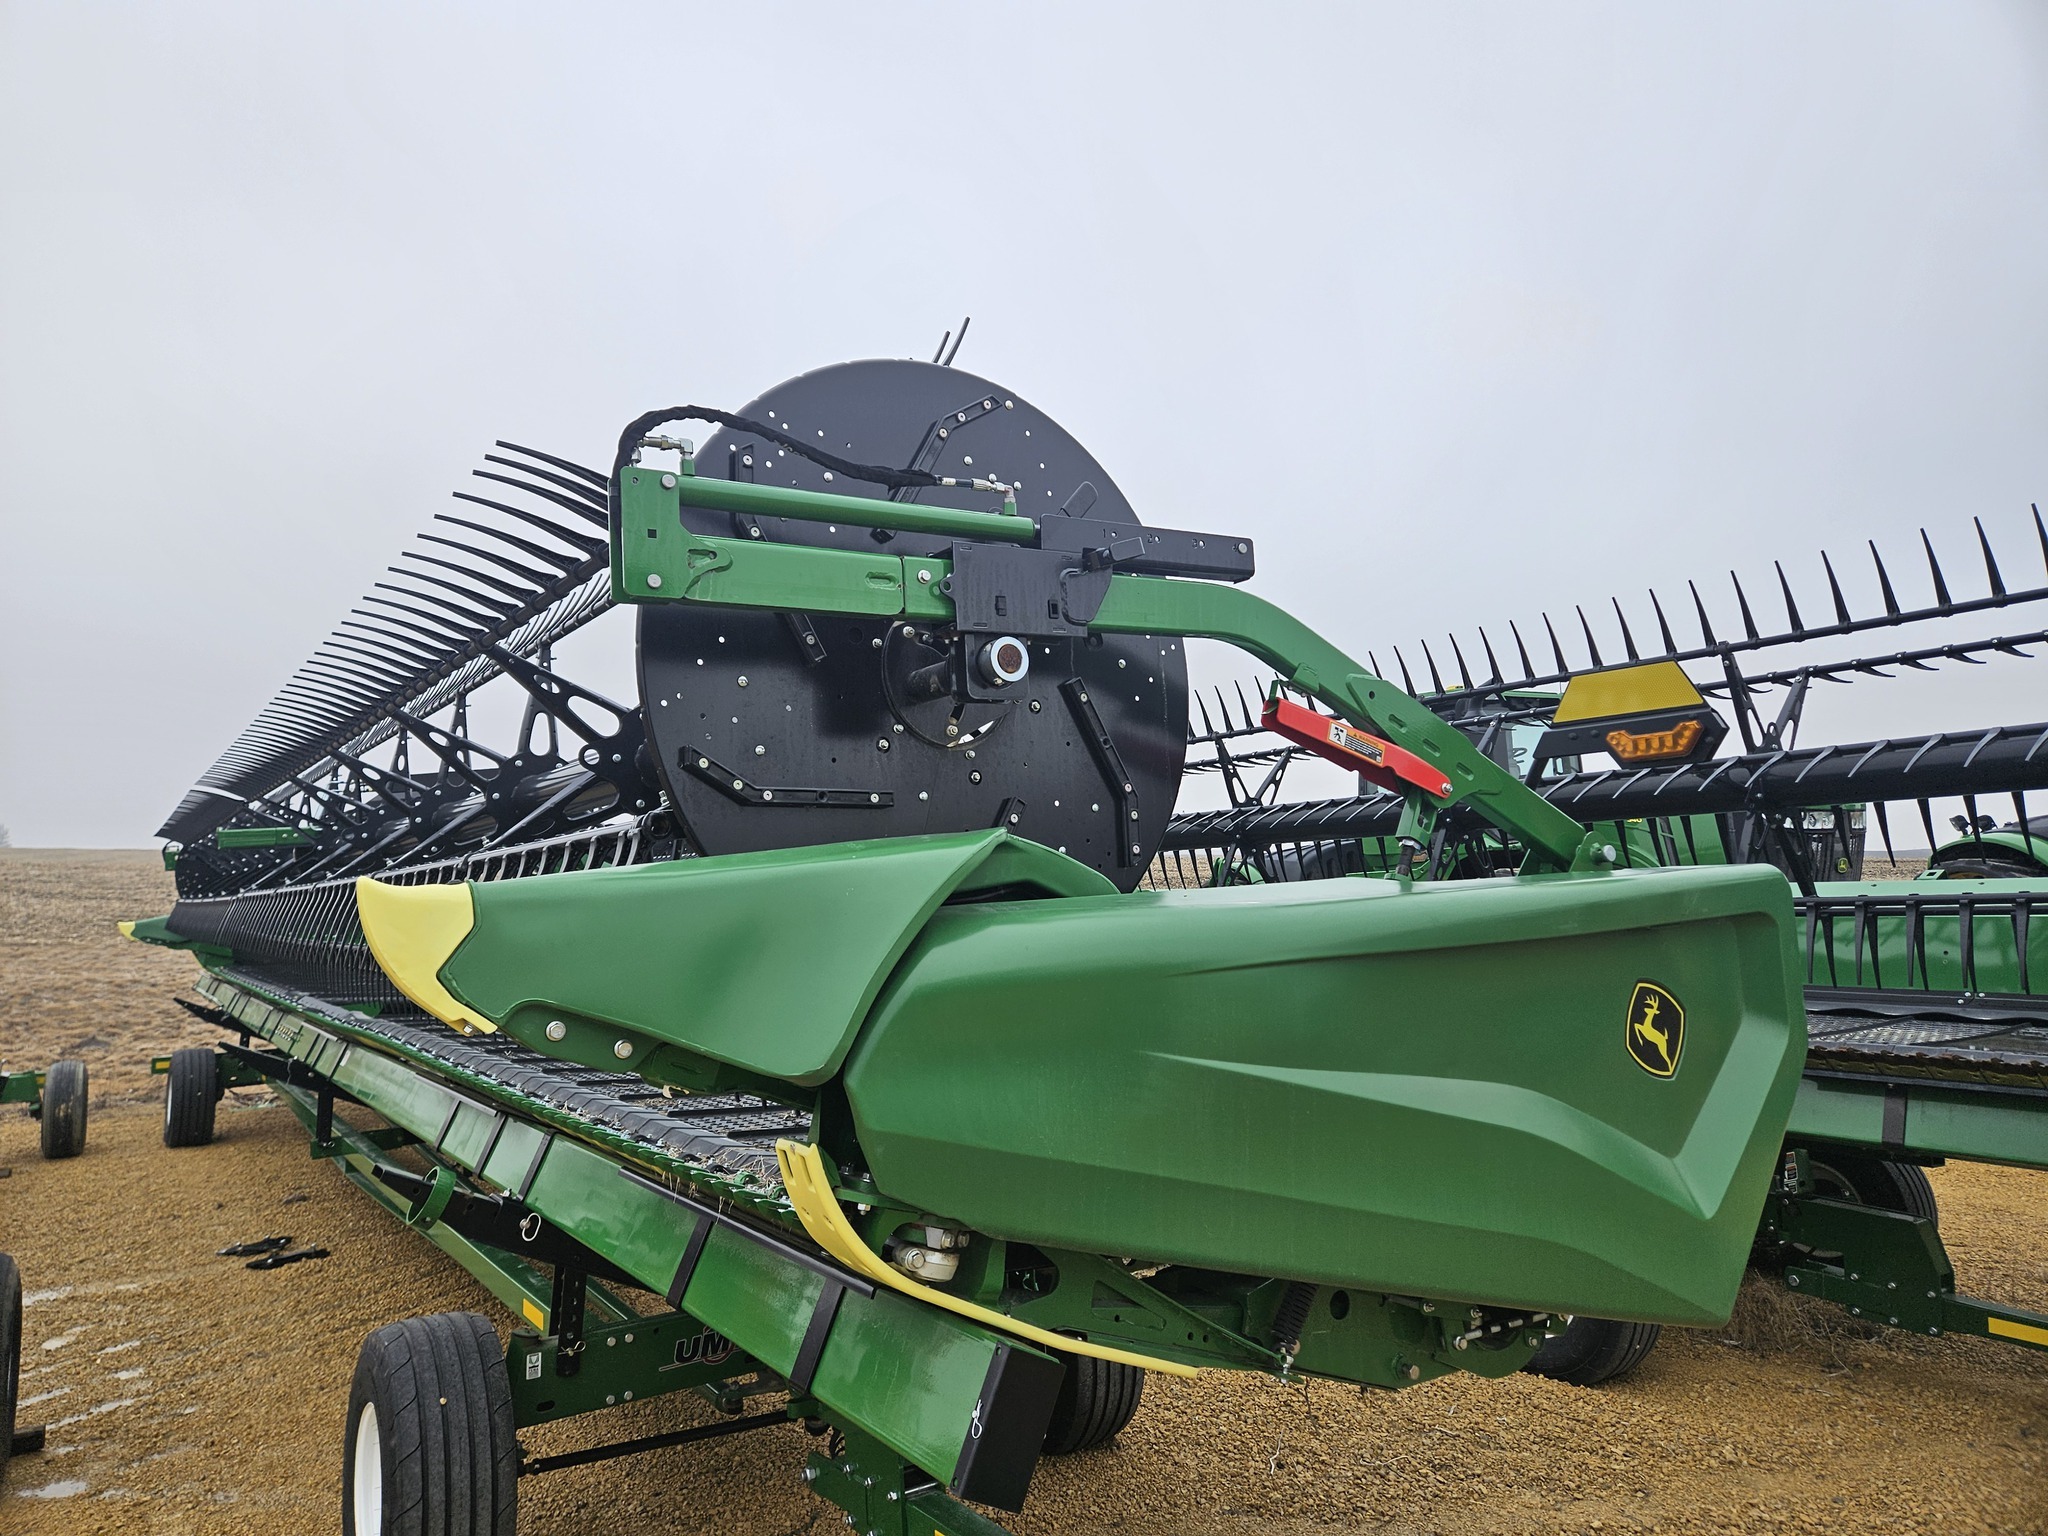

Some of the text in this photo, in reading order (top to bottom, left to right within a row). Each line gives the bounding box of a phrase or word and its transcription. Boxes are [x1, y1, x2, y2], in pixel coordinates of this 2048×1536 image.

[1147, 533, 1153, 544] 2
[1192, 538, 1198, 549] 3
[1358, 734, 1379, 747] WARNING
